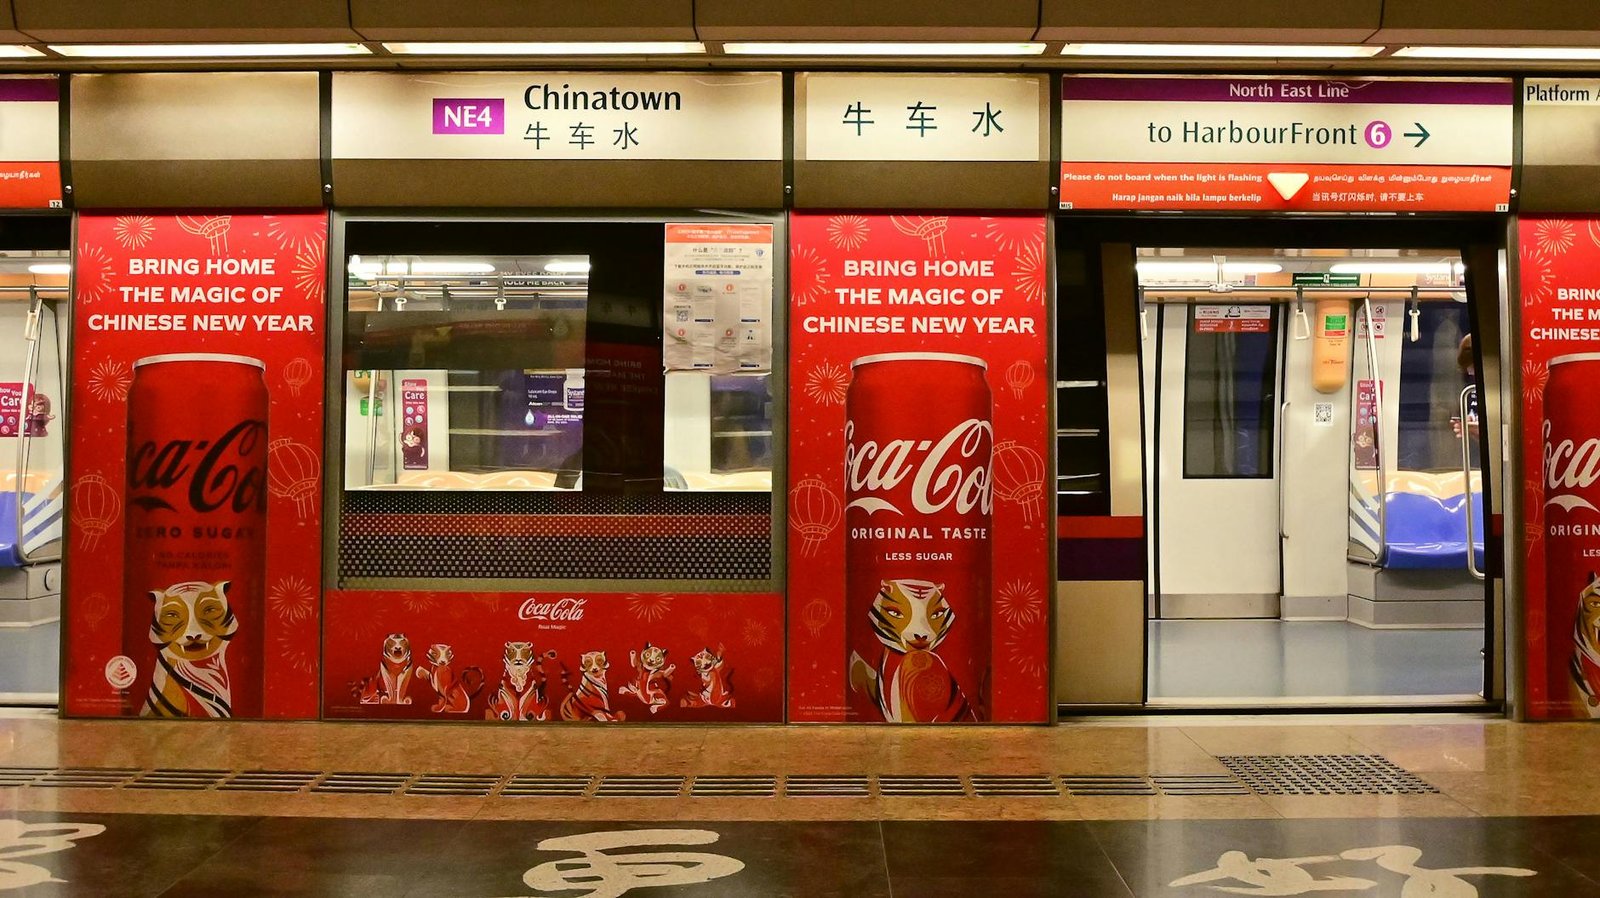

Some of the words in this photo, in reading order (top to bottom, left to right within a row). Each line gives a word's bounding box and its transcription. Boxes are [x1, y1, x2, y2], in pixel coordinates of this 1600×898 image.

[523, 83, 682, 112] Chinatown
[1229, 82, 1274, 98] North
[1281, 82, 1313, 98] East
[1318, 83, 1350, 98] Line
[1526, 84, 1590, 102] Platform
[443, 104, 493, 129] NE4
[1148, 121, 1172, 144] to
[1182, 119, 1358, 146] HarbourFront
[1370, 123, 1387, 146] 6
[1063, 172, 1092, 182] Please
[1093, 172, 1106, 182] do
[1107, 173, 1122, 182] not
[1125, 172, 1151, 182] board
[1153, 172, 1178, 182] when
[1179, 173, 1195, 182] the
[1196, 173, 1217, 184] light
[1218, 173, 1226, 183] is
[1228, 173, 1263, 184] flashing
[1112, 193, 1136, 204] Harap
[1137, 193, 1165, 204] jangan
[1166, 194, 1184, 203] naik
[1185, 194, 1201, 203] bila
[1202, 194, 1227, 205] lampu
[1228, 194, 1262, 205] berkelip
[128, 258, 200, 276] BRING
[206, 258, 276, 276] HOME
[843, 260, 917, 278] BRING
[923, 260, 995, 278] HOME
[119, 287, 165, 304] THE
[170, 287, 247, 304] MAGIC
[251, 287, 284, 304] OF
[834, 288, 882, 306] THE
[887, 288, 966, 306] MAGIC
[971, 288, 1004, 306] OF
[87, 314, 187, 332] CHINESE
[193, 314, 247, 332] NEW
[252, 314, 314, 332] YEAR
[1551, 308, 1585, 321] THE
[803, 316, 905, 335] CHINESE
[912, 316, 967, 335] NEW
[971, 316, 1036, 335] YEAR
[1529, 327, 1600, 341] CHINESE
[404, 391, 426, 400] Care
[851, 526, 933, 541] ORIGINAL
[940, 526, 988, 541] TASTE
[885, 552, 912, 562] LESS
[916, 552, 953, 562] SUGAR
